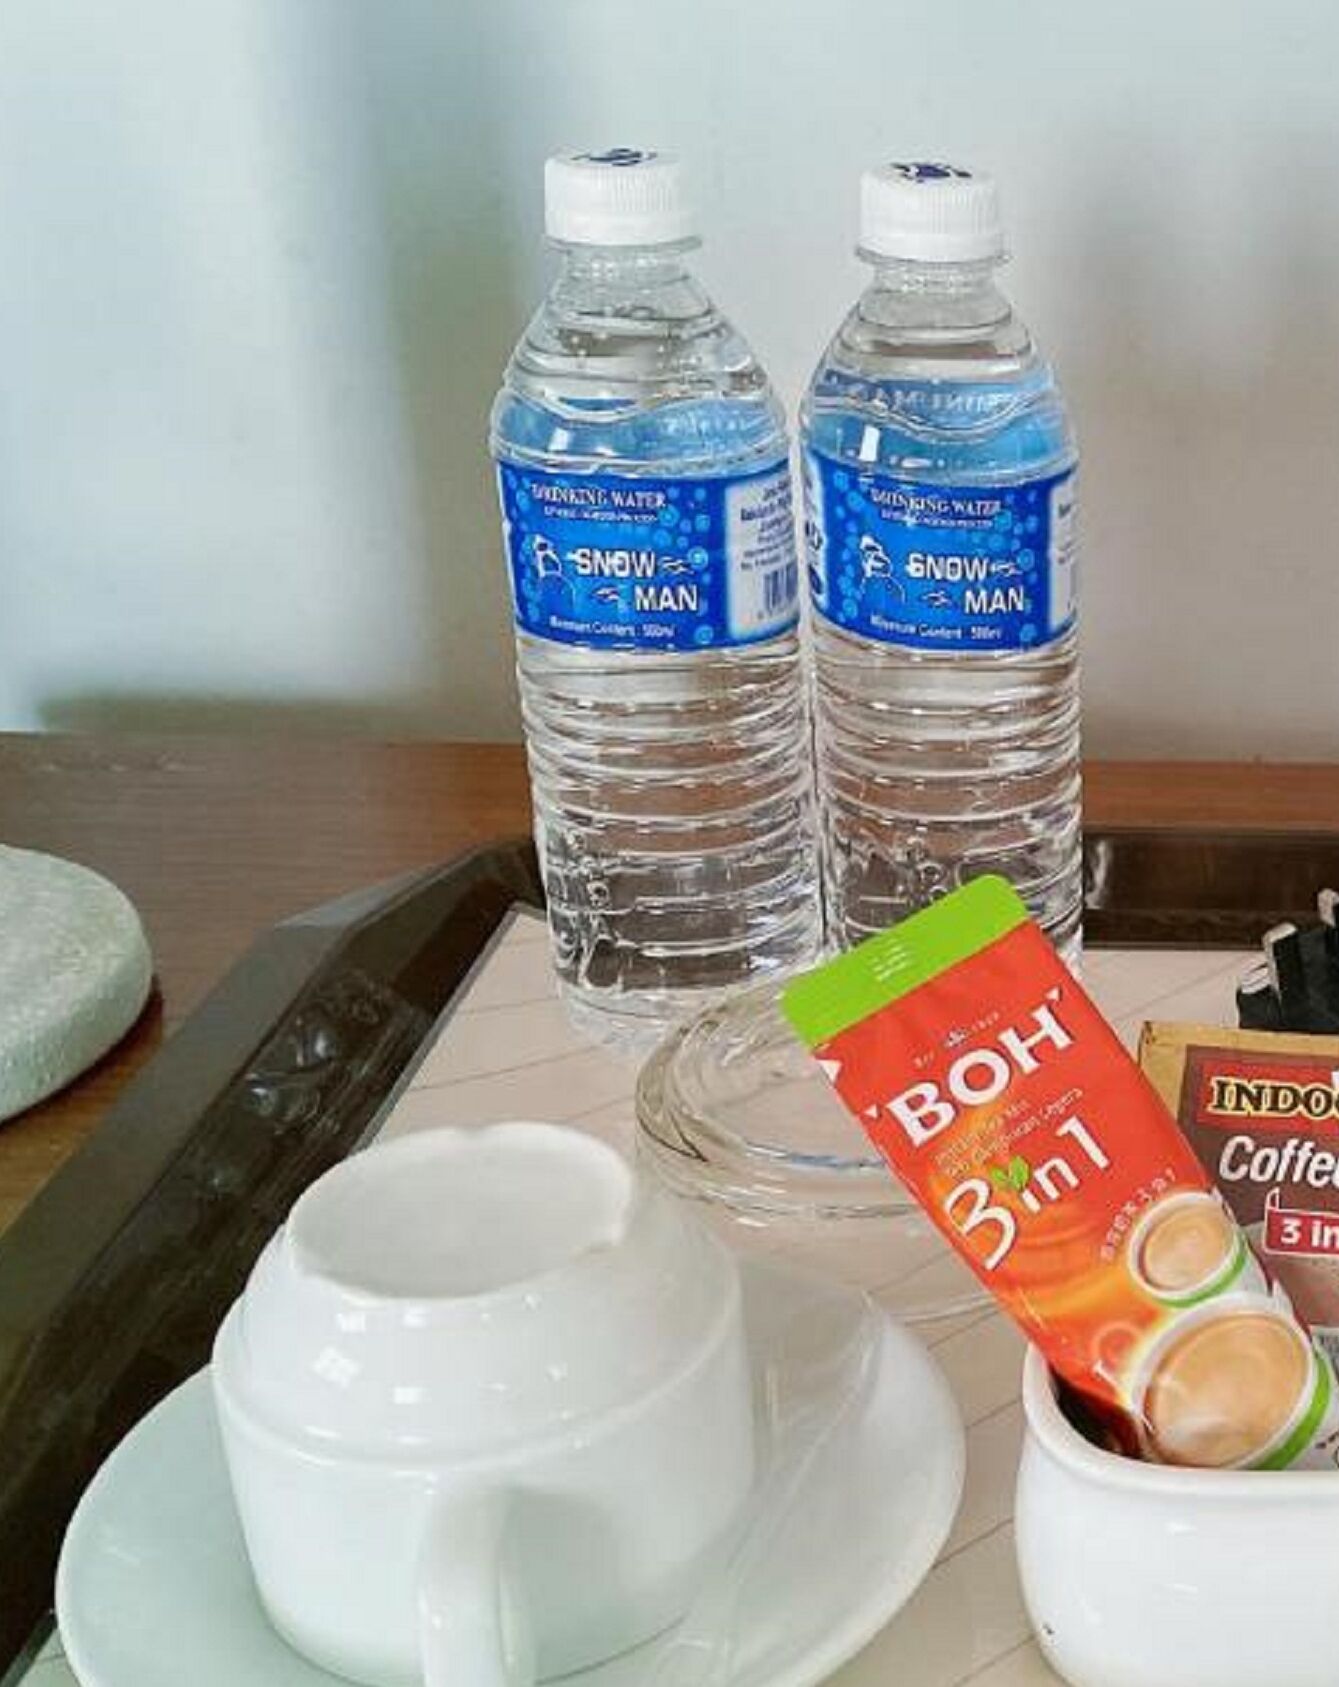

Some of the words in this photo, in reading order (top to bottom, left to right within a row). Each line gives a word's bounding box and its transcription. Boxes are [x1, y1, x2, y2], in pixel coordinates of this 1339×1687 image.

[611, 489, 667, 508] WATER
[575, 548, 656, 578] SNOW
[908, 552, 988, 581] SNOW
[634, 585, 698, 612] MAN
[964, 587, 1024, 615] MAN
[885, 1003, 1075, 1148] BOH
[943, 1176, 1018, 1271] 3
[1013, 1157, 1083, 1214] in
[1056, 1115, 1111, 1171] 1
[1280, 1218, 1302, 1246] 3
